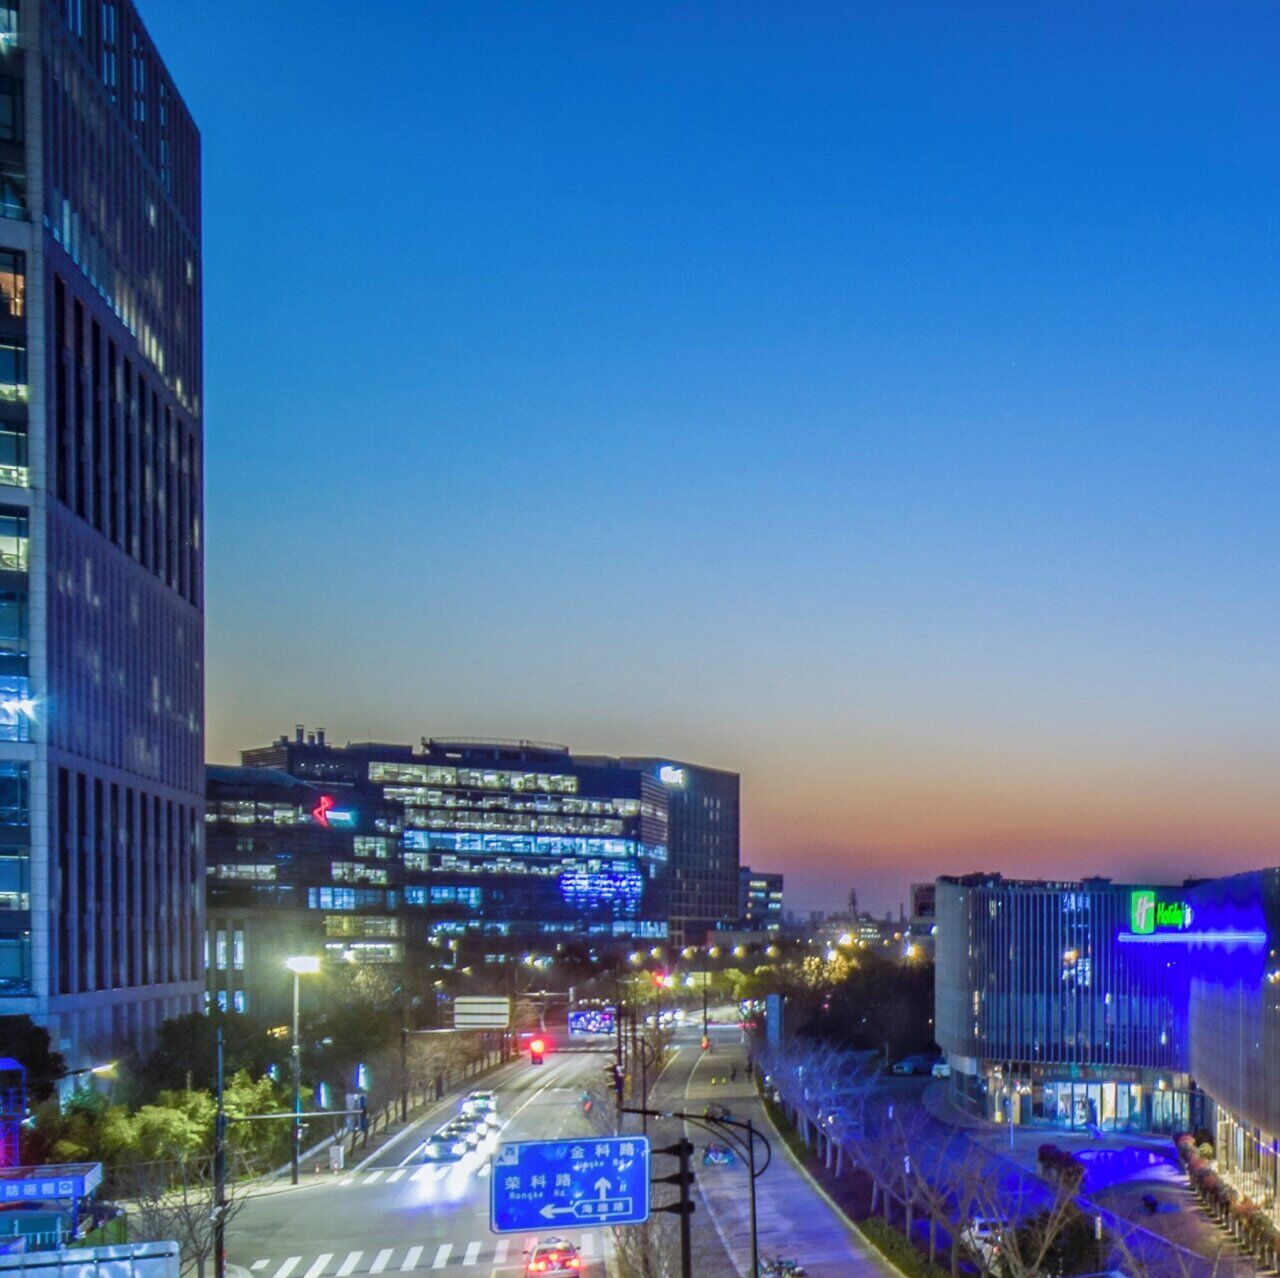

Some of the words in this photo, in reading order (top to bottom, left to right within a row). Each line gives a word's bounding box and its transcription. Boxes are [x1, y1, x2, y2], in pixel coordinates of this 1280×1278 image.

[570, 1143, 635, 1159] 金科路
[505, 1173, 571, 1190] 荣科路
[0, 1182, 55, 1197] 防砸棚
[509, 1191, 544, 1202] Rongke
